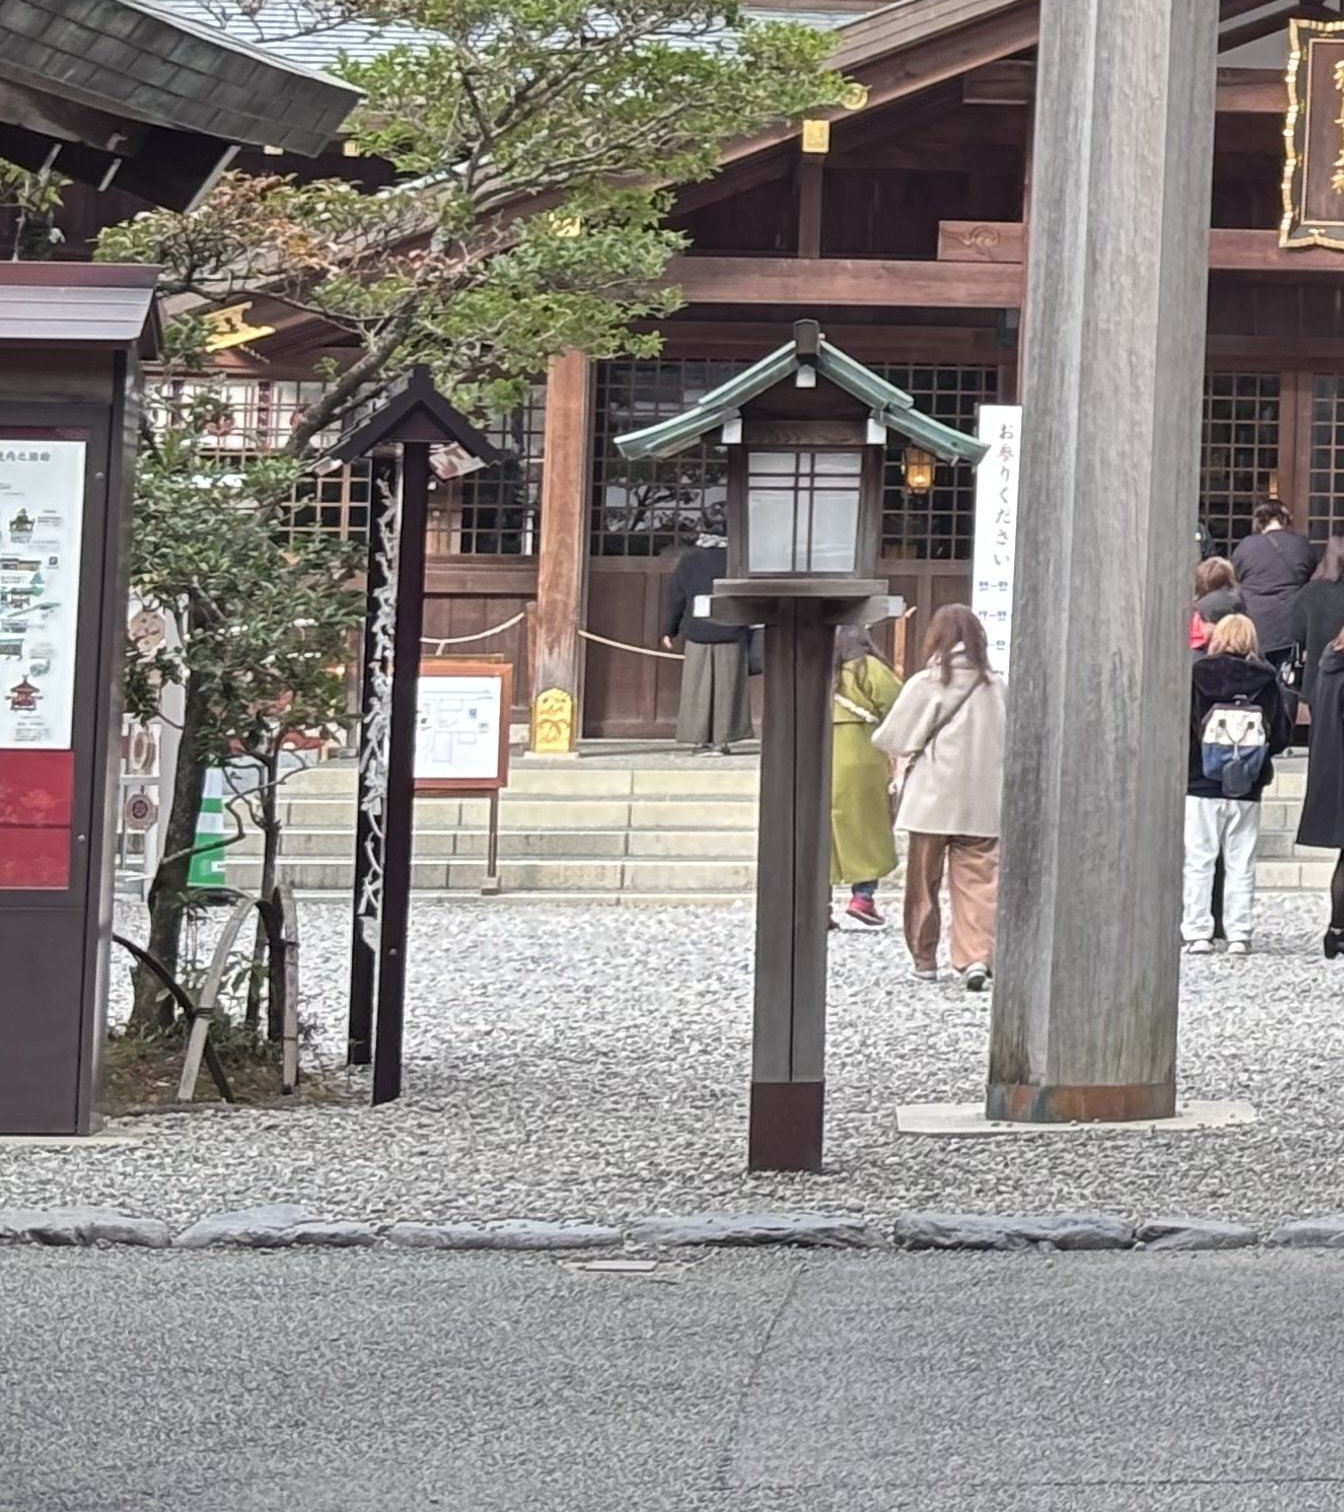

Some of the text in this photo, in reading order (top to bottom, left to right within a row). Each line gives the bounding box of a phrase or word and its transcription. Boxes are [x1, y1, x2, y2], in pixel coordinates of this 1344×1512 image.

[994, 424, 1014, 567] お参りください
